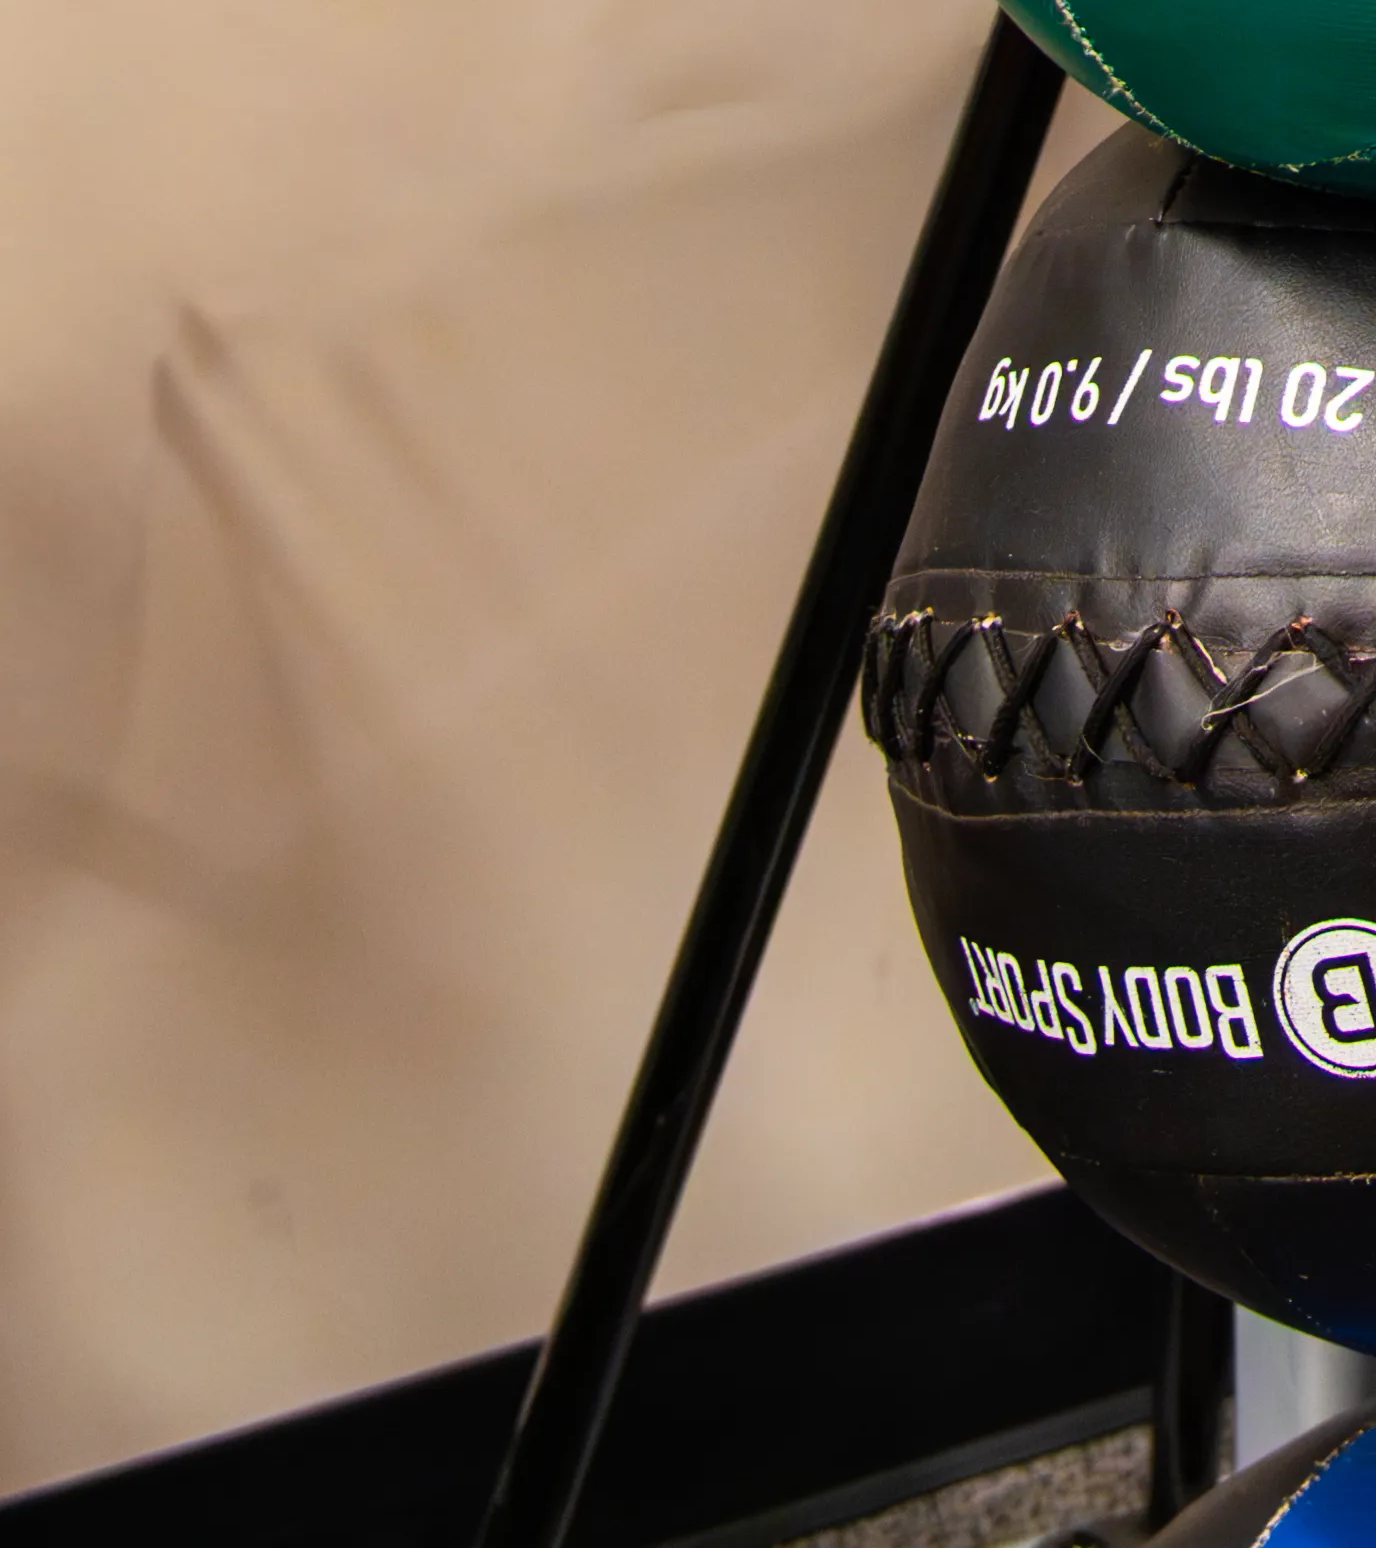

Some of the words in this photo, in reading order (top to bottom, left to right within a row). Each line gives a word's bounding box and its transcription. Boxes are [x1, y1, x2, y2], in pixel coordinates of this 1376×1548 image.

[1106, 348, 1153, 425] /
[1159, 354, 1264, 423] lbs
[1279, 360, 1376, 433] 20
[959, 935, 1097, 1056] SPORT
[1098, 963, 1264, 1060] BODY
